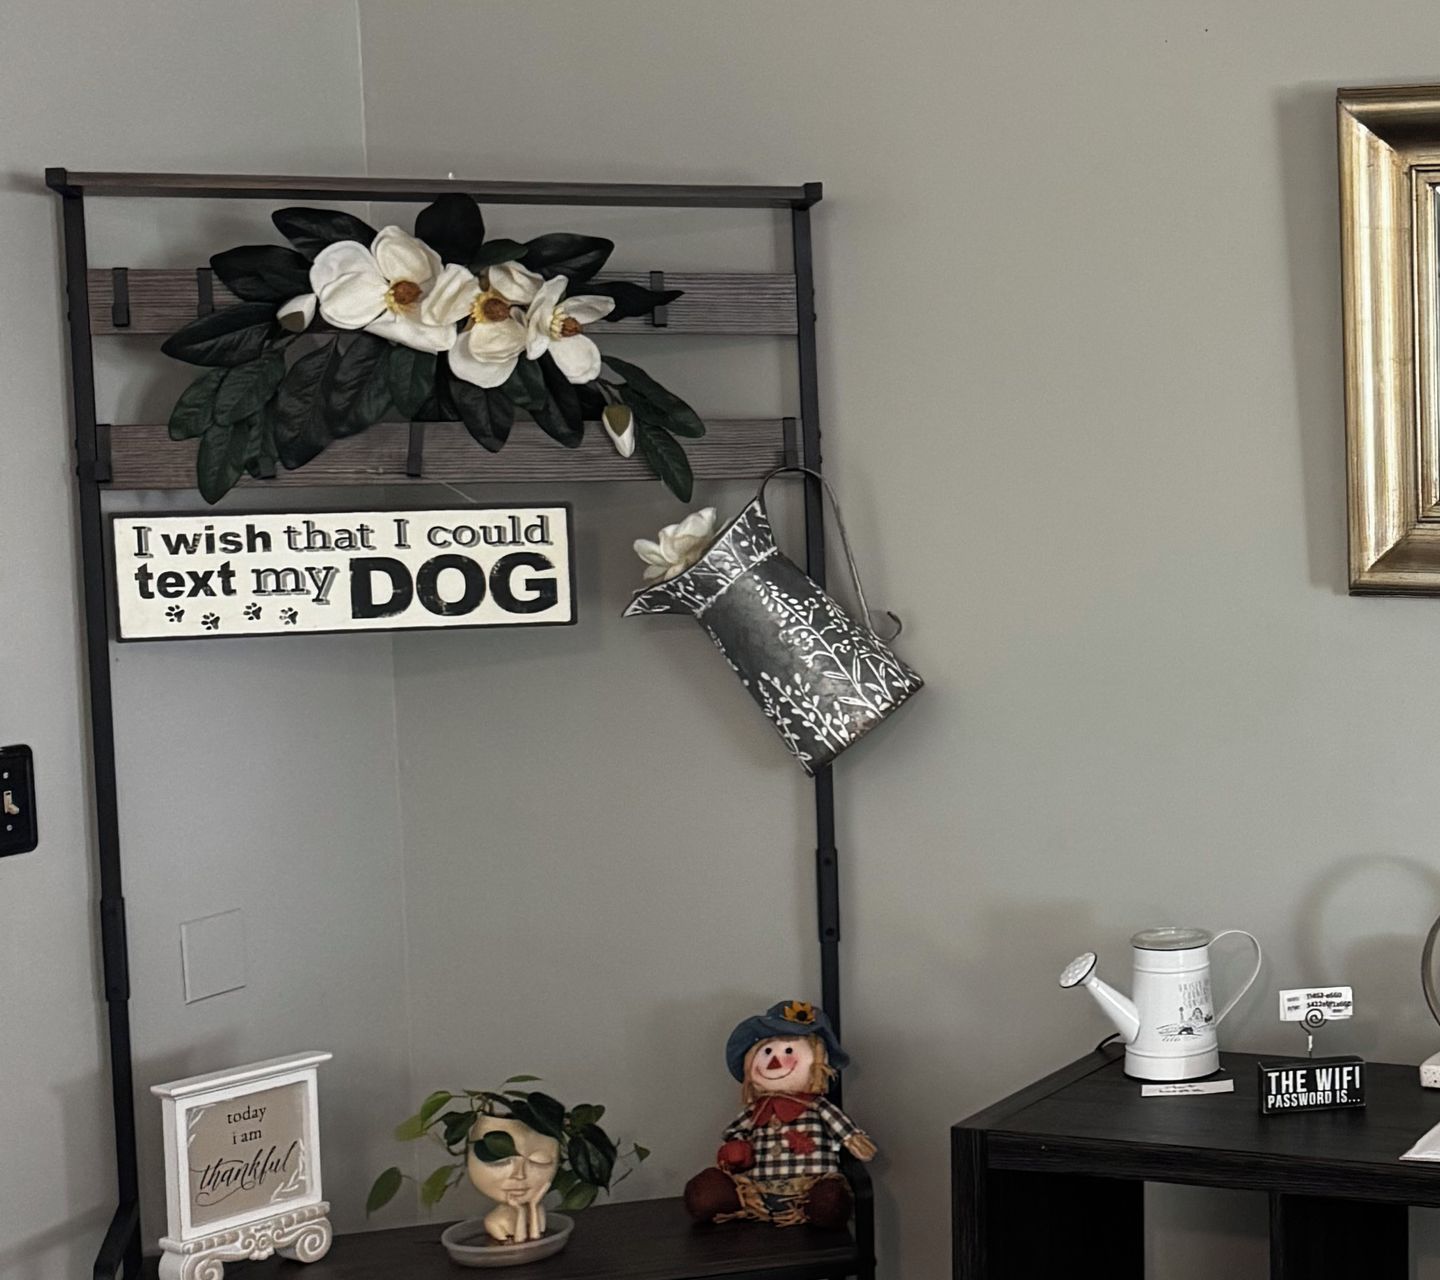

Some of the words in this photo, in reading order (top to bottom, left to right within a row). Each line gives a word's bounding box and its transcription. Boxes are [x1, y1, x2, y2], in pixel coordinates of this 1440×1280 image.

[134, 526, 153, 558] I
[161, 524, 272, 554] wish
[283, 520, 376, 551] that
[394, 519, 411, 549] I
[426, 515, 553, 547] could
[134, 562, 237, 599] text
[251, 565, 339, 604] my
[349, 552, 558, 619] DOG
[1268, 1072, 1306, 1094] THE
[1316, 1066, 1360, 1092] WIFI
[1267, 1092, 1331, 1108] PASSWORD
[1336, 1090, 1360, 1103] IS...
[227, 1105, 266, 1124] today
[233, 1133, 236, 1144] i
[241, 1130, 262, 1142] am
[189, 1140, 297, 1206] thankful
